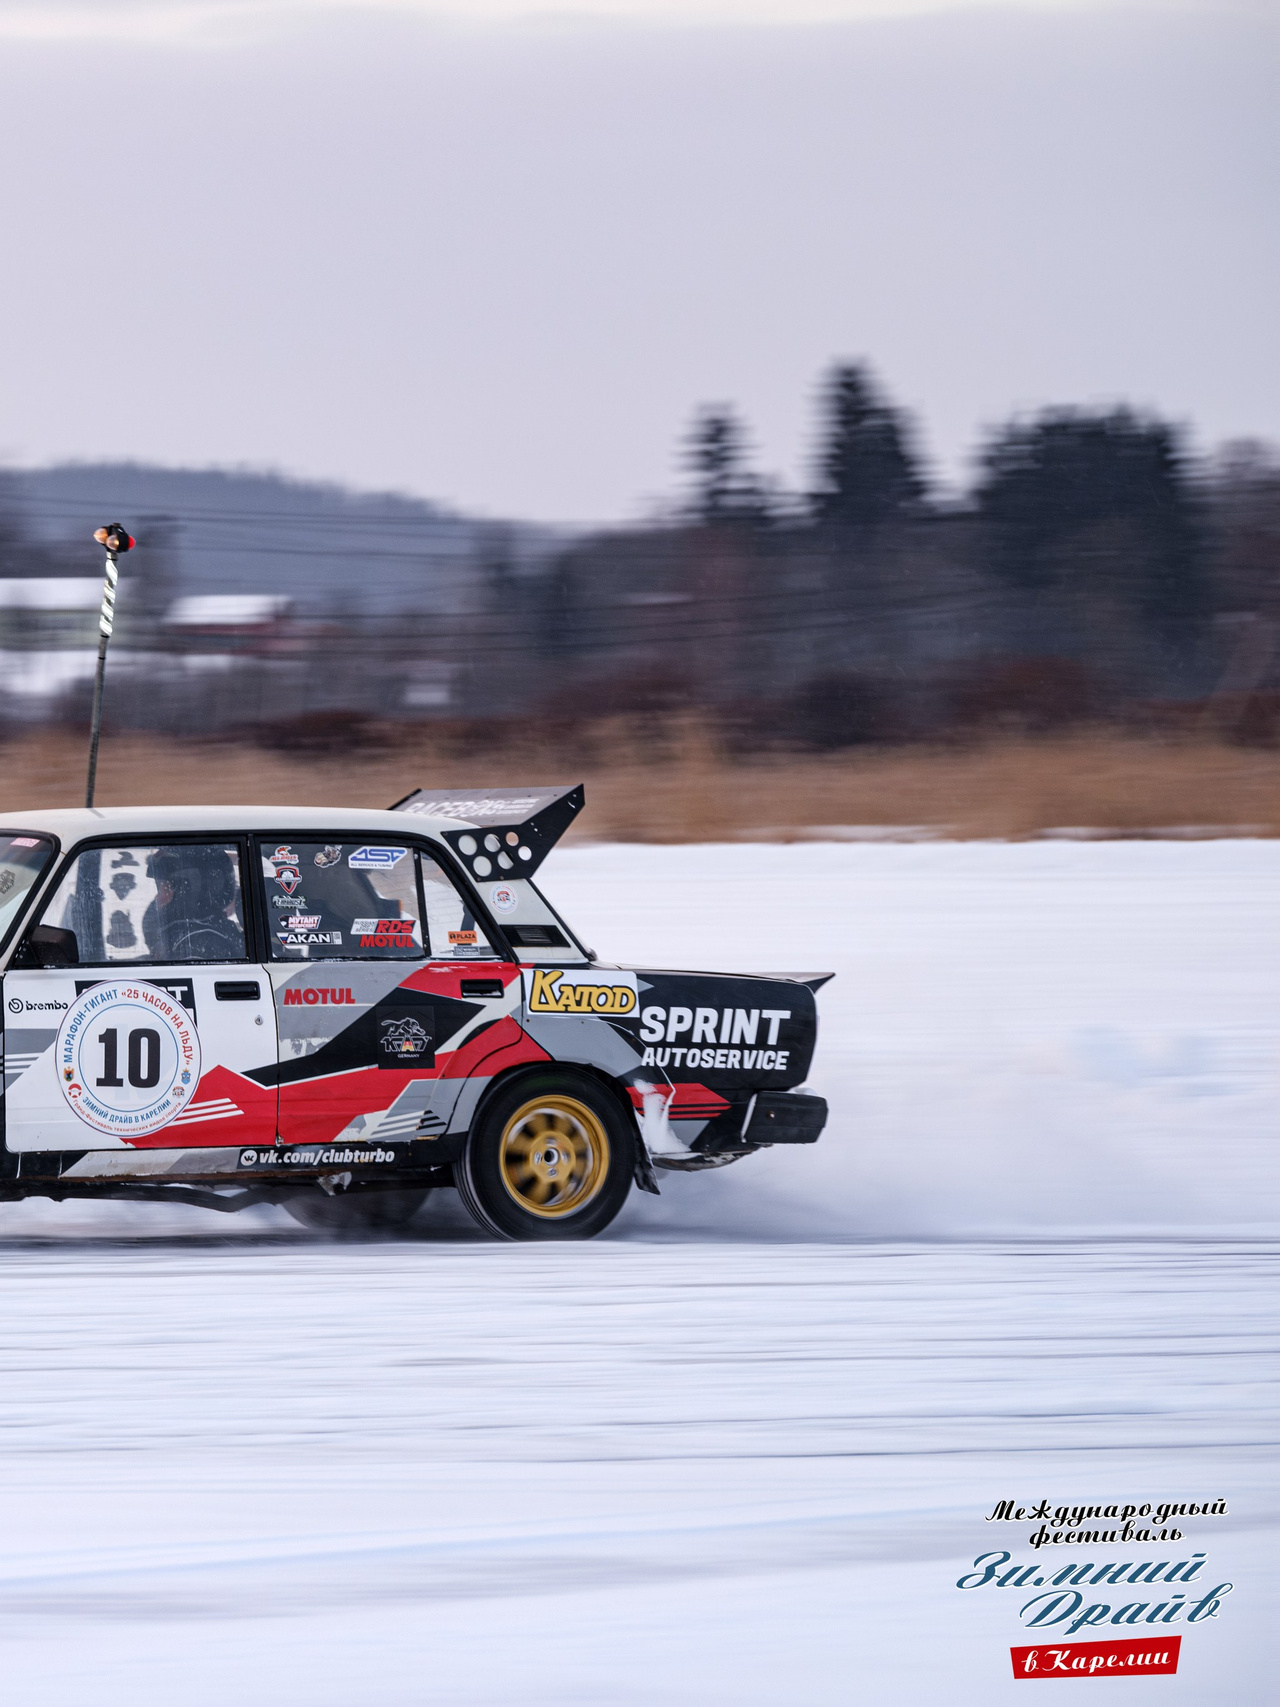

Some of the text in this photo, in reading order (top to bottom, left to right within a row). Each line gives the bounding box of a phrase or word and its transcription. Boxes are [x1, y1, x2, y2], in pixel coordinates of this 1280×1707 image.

[376, 920, 416, 933] RDS
[286, 933, 331, 943] AKAN
[360, 934, 415, 948] MOTUL
[26, 1000, 68, 1010] brembo
[283, 988, 356, 1005] MOTUL
[142, 991, 173, 1016] ЧАСОВ
[170, 1013, 184, 1029] НА
[639, 1005, 791, 1045] SPRINT
[96, 1027, 161, 1088] 10
[641, 1046, 790, 1070] AUTOSERVICE
[82, 1096, 109, 1120] ЗИМНИЙ
[109, 1113, 133, 1124] ДРАЙВ
[140, 1098, 172, 1121] КАРЕЛИИ
[259, 1148, 395, 1166] vk.com/clubturbo
